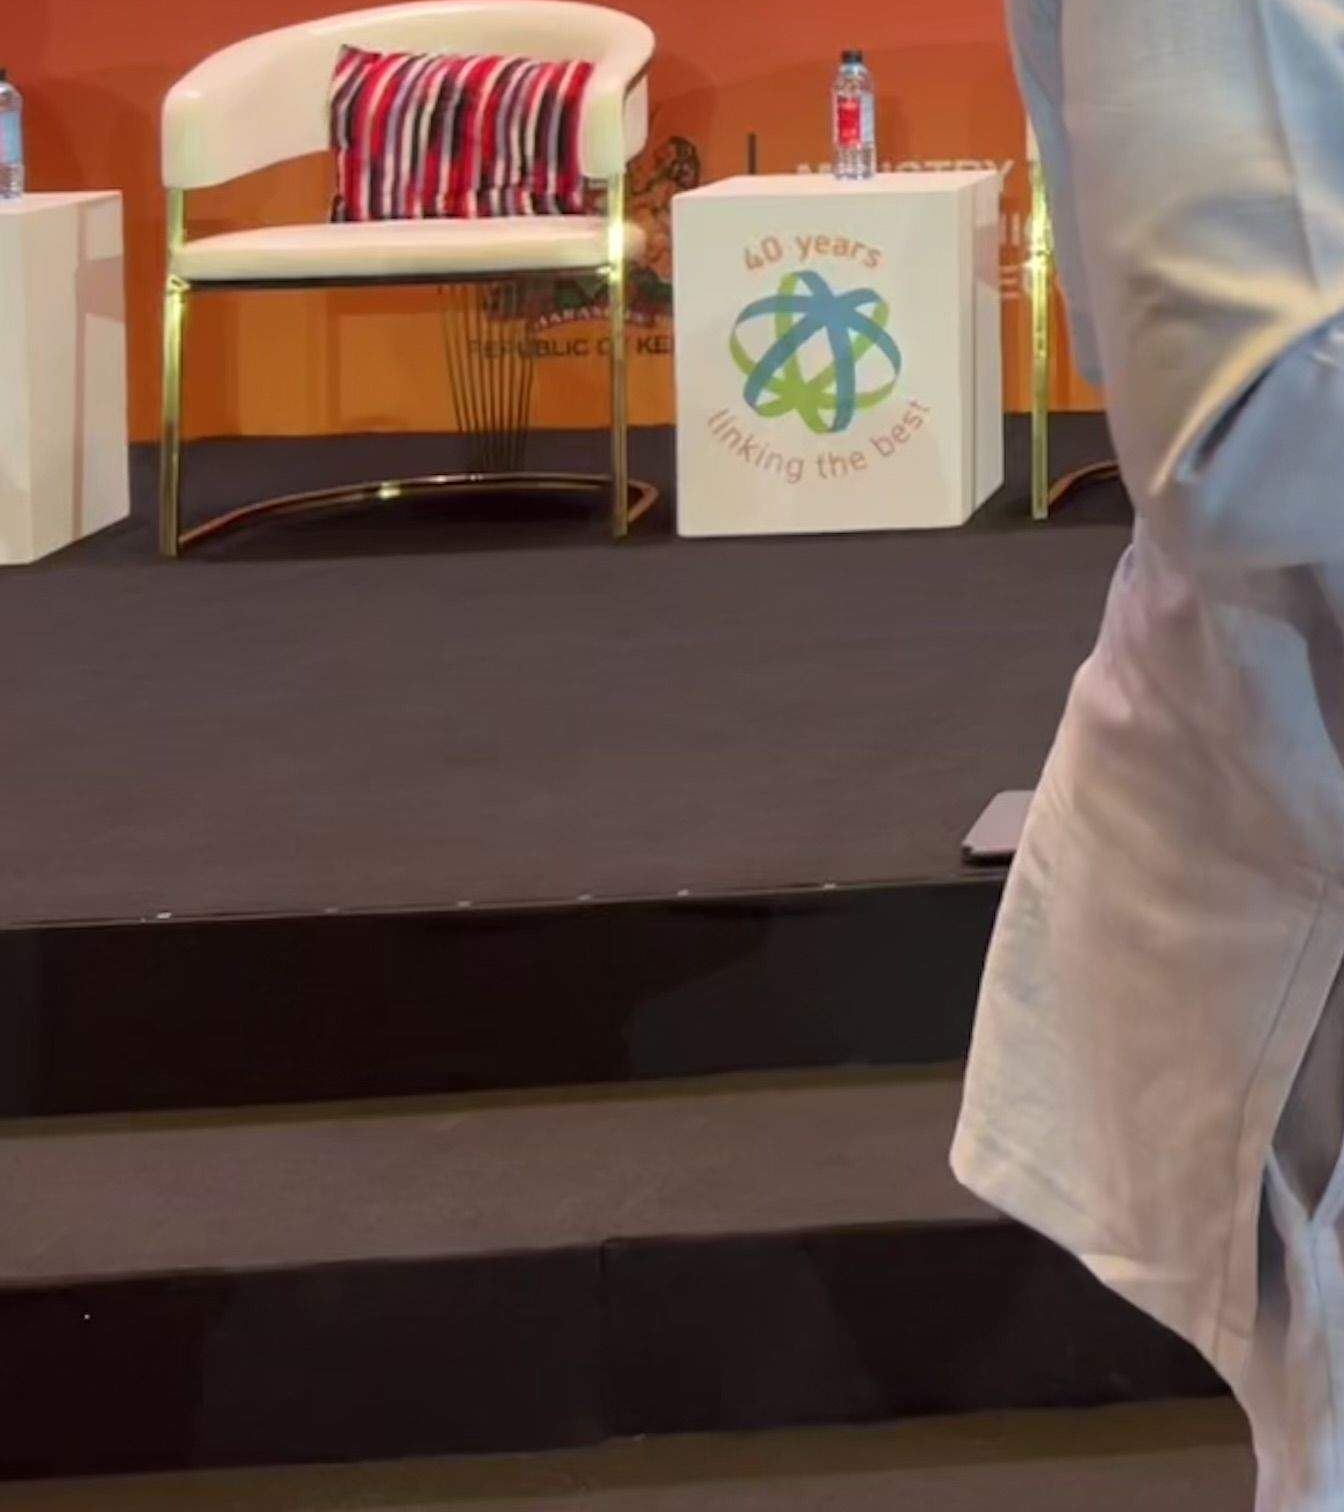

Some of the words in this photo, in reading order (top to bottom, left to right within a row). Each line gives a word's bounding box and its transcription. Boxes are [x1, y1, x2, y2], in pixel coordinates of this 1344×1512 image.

[743, 235, 784, 271] 40
[796, 233, 884, 269] years
[707, 407, 805, 485] linking
[815, 450, 869, 480] the
[869, 398, 931, 459] best
